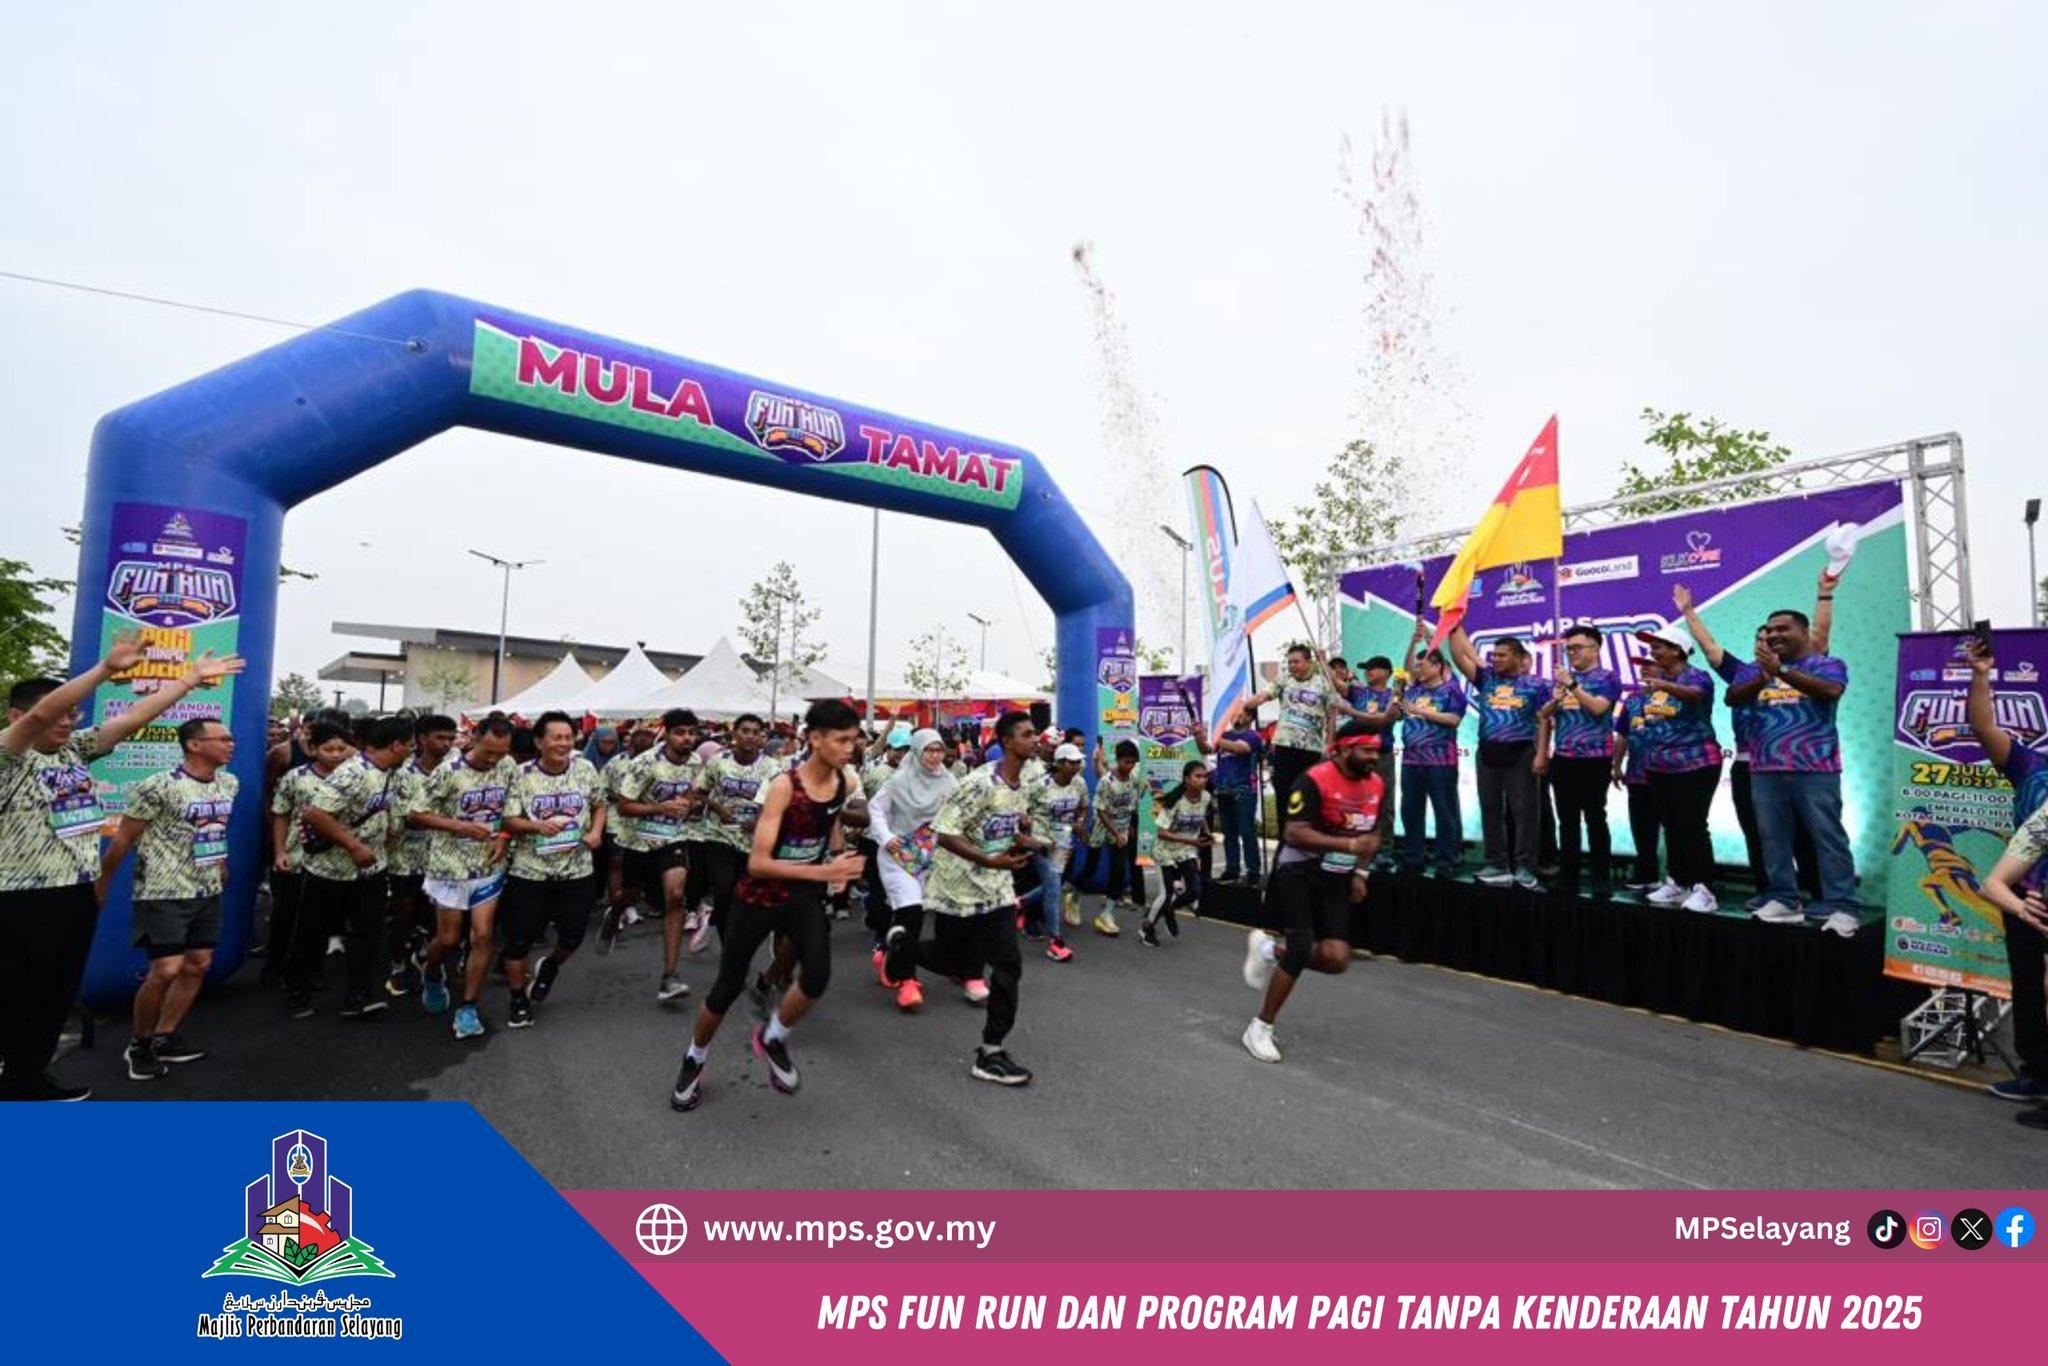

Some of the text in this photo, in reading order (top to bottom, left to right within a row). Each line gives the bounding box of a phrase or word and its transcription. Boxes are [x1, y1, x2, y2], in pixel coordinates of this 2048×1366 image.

[517, 337, 714, 426] MULA
[753, 396, 794, 428] FUN
[859, 425, 1022, 492] TAMAT
[157, 561, 195, 572] MPS
[116, 567, 229, 604] FUN RUN
[1532, 615, 1594, 637] MPS
[1908, 698, 1967, 728] FUN
[1911, 762, 1950, 786] 27
